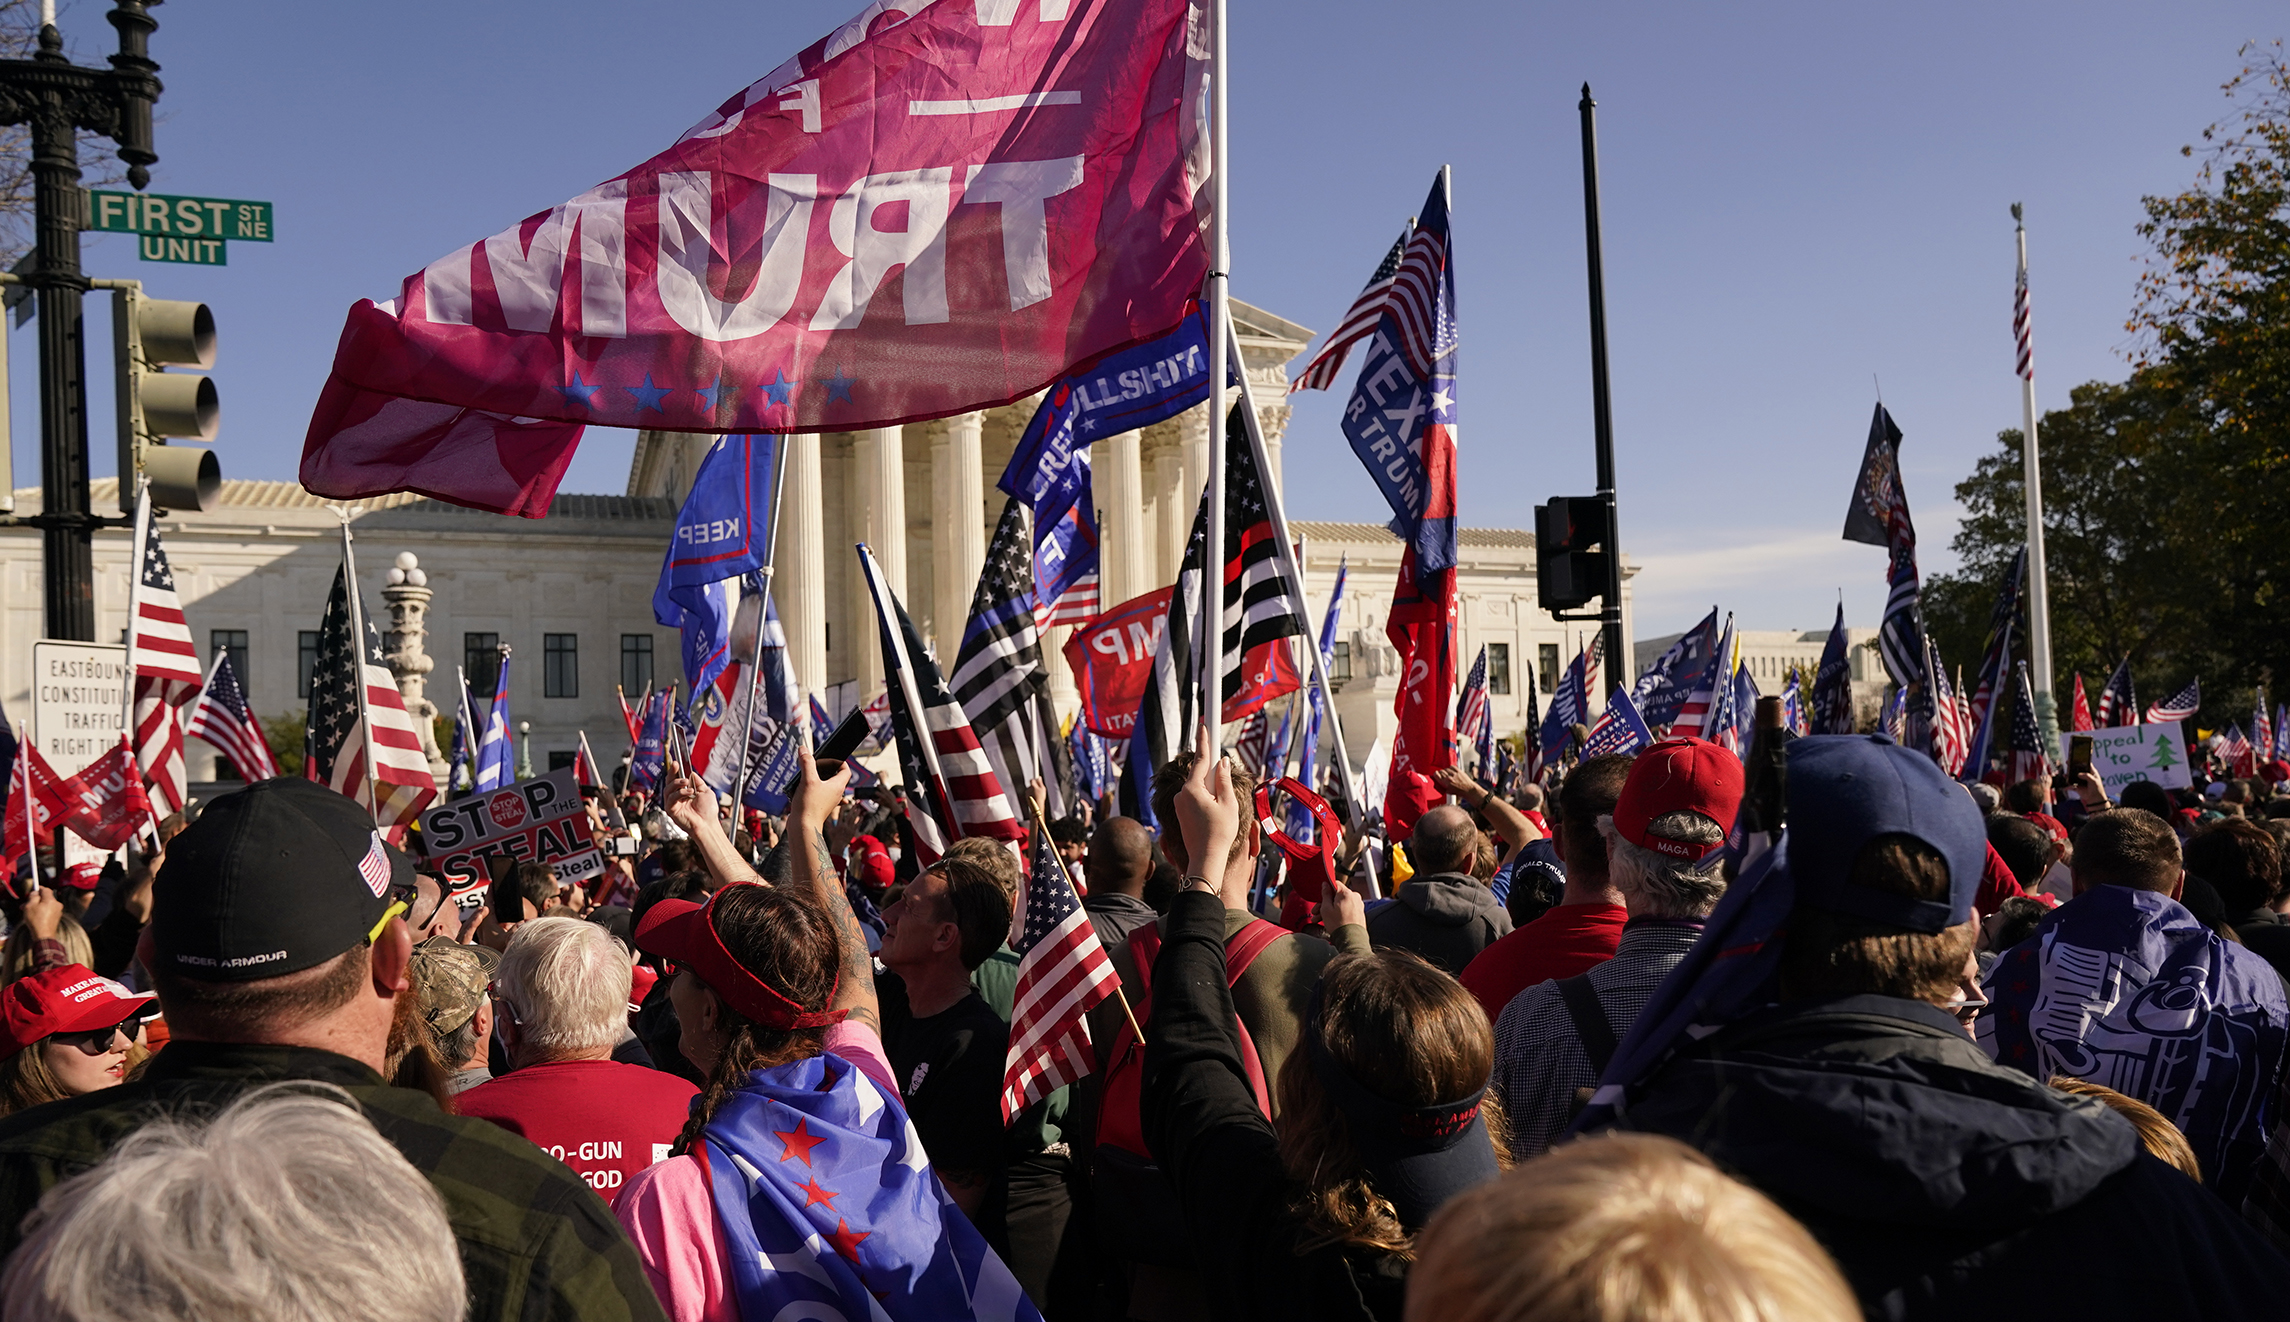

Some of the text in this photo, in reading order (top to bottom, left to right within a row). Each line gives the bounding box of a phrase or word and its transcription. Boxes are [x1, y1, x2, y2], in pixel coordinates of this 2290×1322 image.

[99, 194, 264, 236] FIRST ST
[238, 221, 268, 239] NE
[143, 236, 222, 263] UNIT
[1072, 344, 1205, 422] ULLSHIT
[1361, 416, 1421, 520] TRUM
[65, 712, 122, 730] TRAFFIC
[51, 738, 93, 755] RIGHT
[2092, 726, 2143, 758] ppeal
[2109, 751, 2131, 766] to
[492, 797, 519, 812] STOP
[551, 798, 578, 814] THE
[495, 811, 524, 822] STEAL
[1657, 841, 1690, 857] MAGA
[1545, 861, 1567, 885] TRUMP
[177, 950, 288, 968] UNDER ARMOUR
